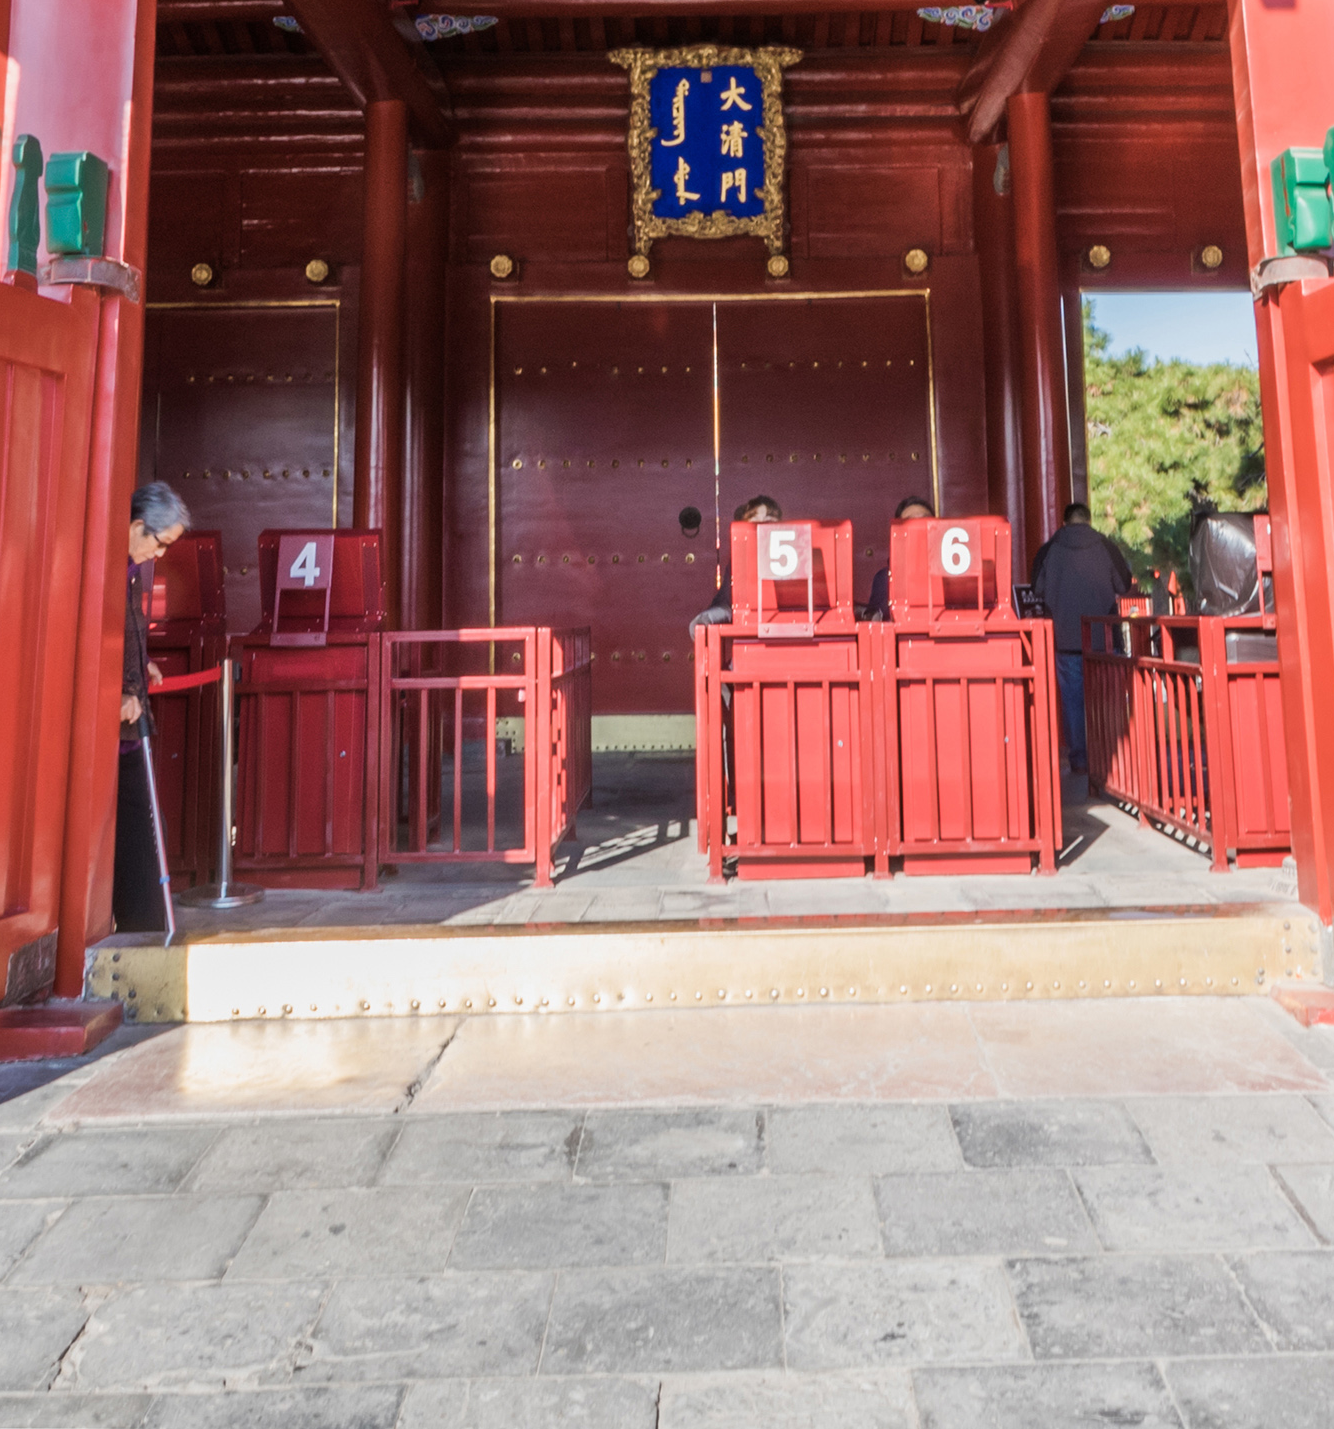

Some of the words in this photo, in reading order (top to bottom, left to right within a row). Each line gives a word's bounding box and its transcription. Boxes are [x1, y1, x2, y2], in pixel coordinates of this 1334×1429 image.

[720, 77, 752, 203] 大清門
[290, 542, 320, 586] 4
[769, 530, 798, 576] 5
[941, 527, 971, 575] 6
